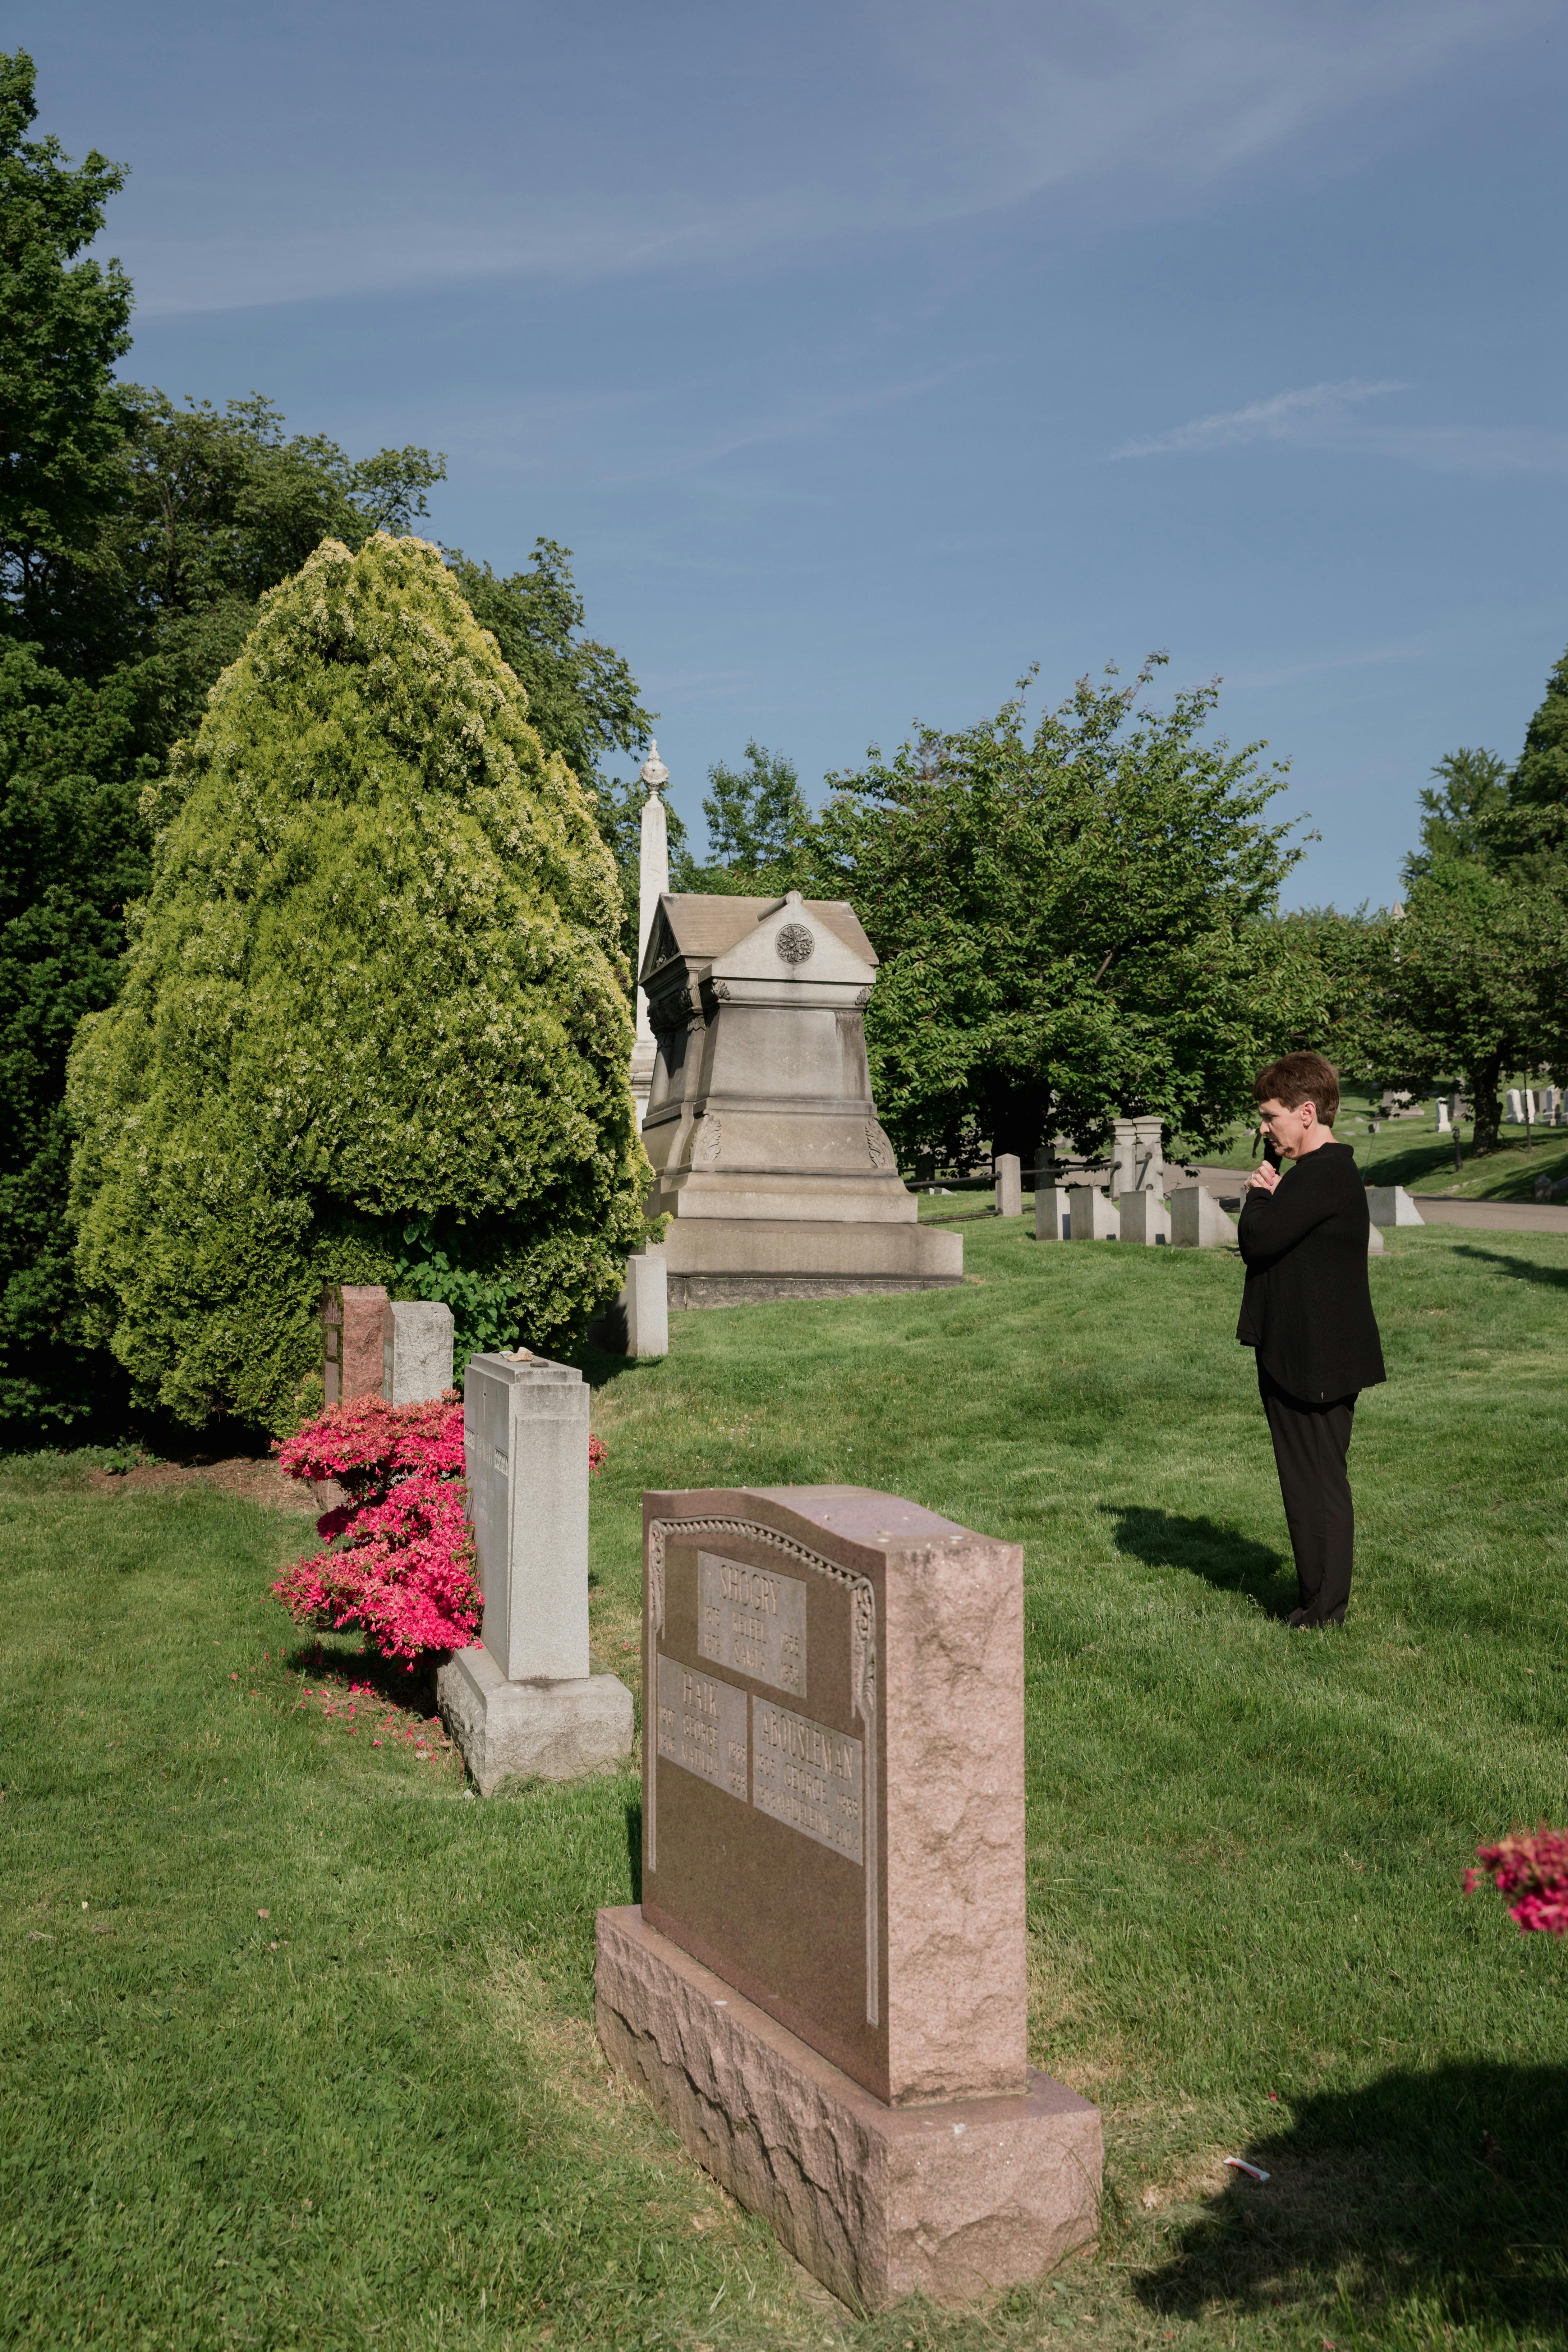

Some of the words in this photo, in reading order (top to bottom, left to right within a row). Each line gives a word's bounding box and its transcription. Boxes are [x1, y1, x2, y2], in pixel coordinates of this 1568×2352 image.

[719, 1565, 781, 1616] SHOGRY
[780, 1633, 799, 1656] 1955
[684, 1671, 719, 1719] HAIK
[660, 1706, 675, 1727] 1907
[684, 1713, 718, 1749] GEORGE
[762, 1709, 853, 1783] ABOUSLEMAN
[682, 1741, 719, 1779] MATILDA
[756, 1754, 774, 1778] 1905
[784, 1762, 827, 1804] GEORGE
[778, 1790, 832, 1839] MADELEINE
[834, 1824, 858, 1855] 2004
